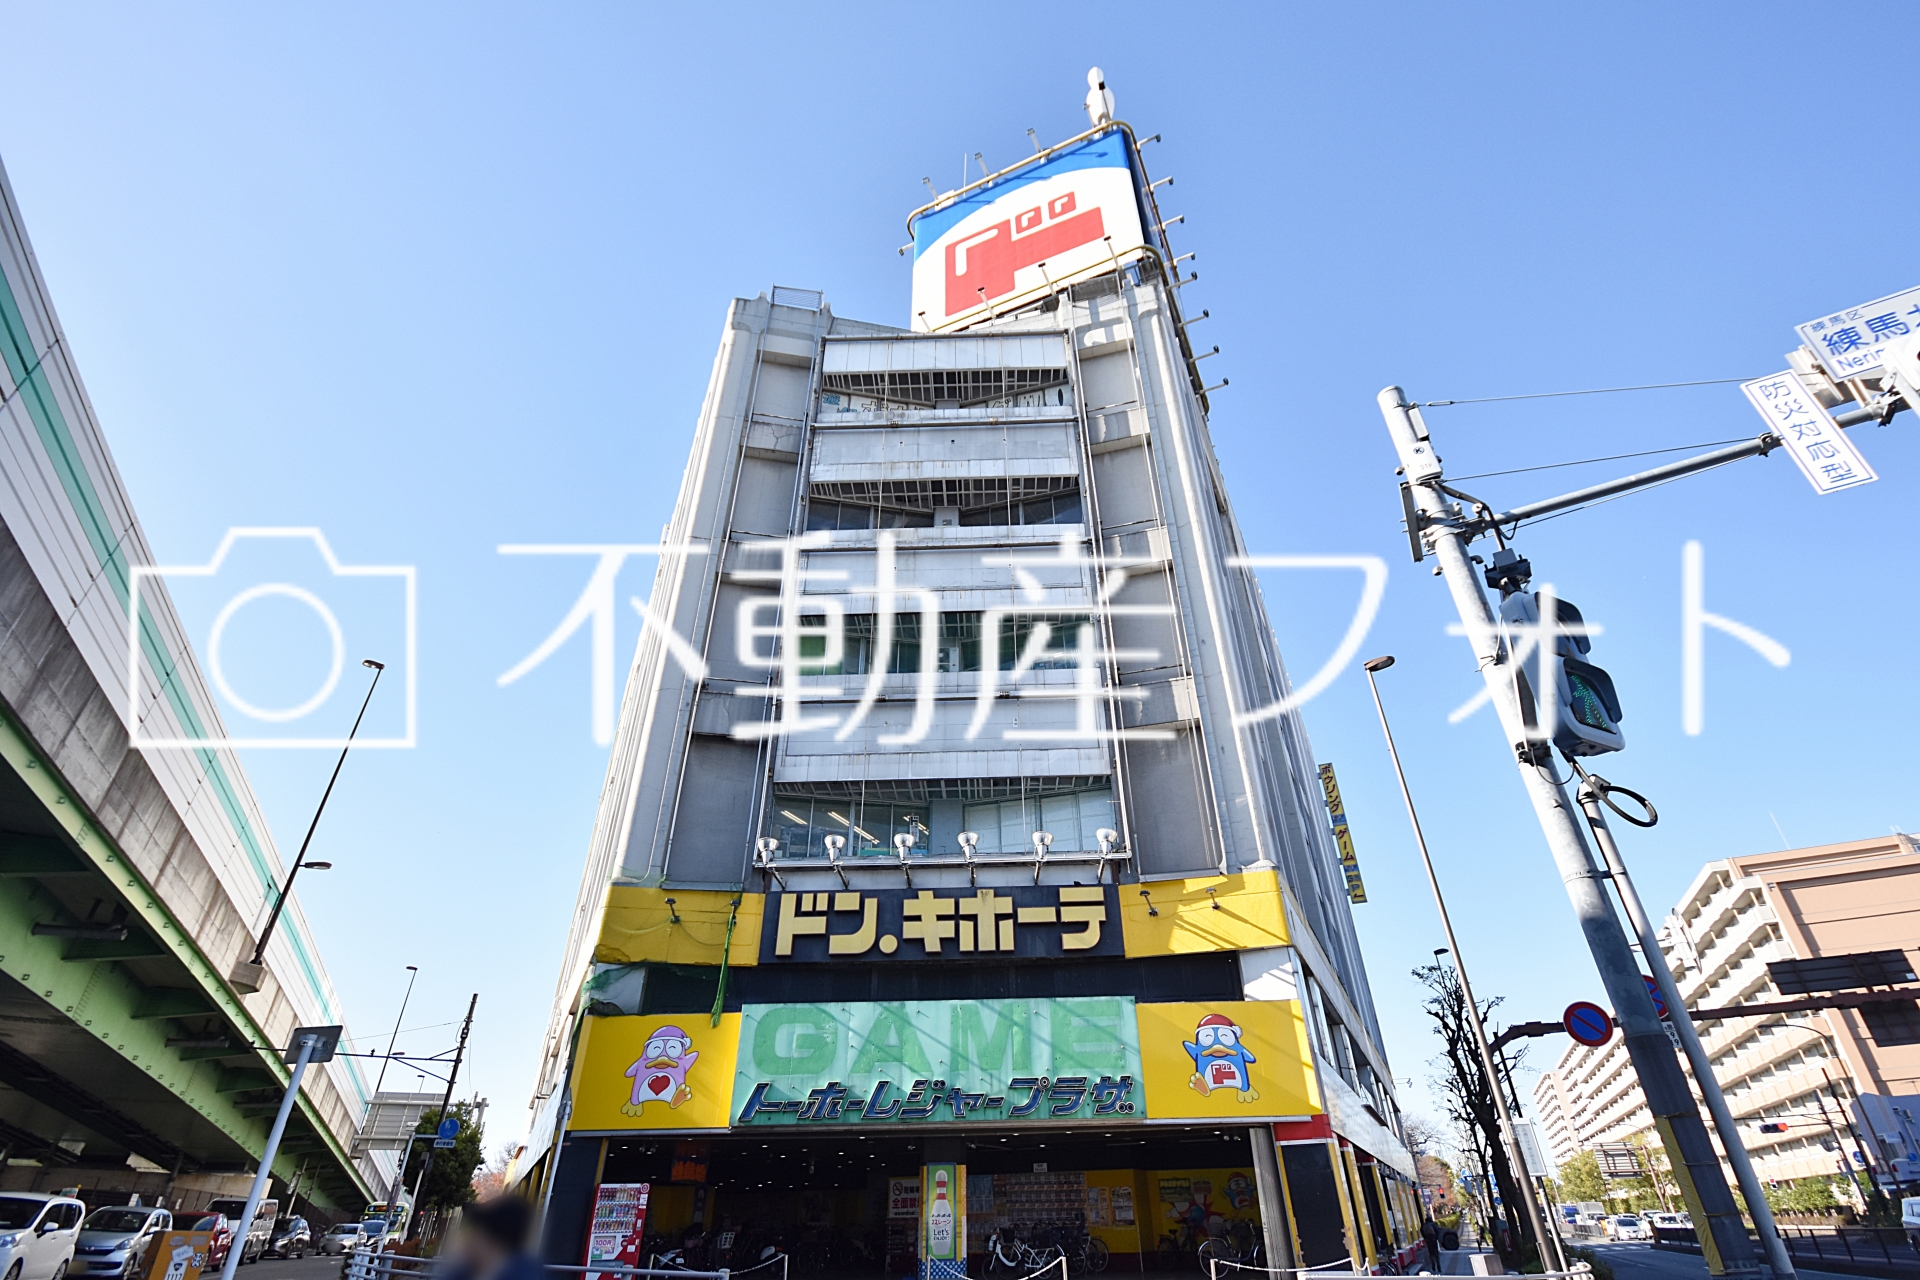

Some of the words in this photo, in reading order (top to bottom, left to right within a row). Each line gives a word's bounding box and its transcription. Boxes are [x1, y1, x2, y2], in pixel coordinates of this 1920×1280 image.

[1810, 308, 1865, 333] 練馬区
[1758, 380, 1858, 484] 防災対応型
[1321, 764, 1341, 813] ボウリング
[1336, 828, 1355, 861] ゲーム
[752, 1001, 1127, 1076] GAME
[737, 1075, 1136, 1122] トーホーレジャープラザ
[892, 1198, 920, 1209] 全面禁
[933, 1228, 950, 1236] Let's
